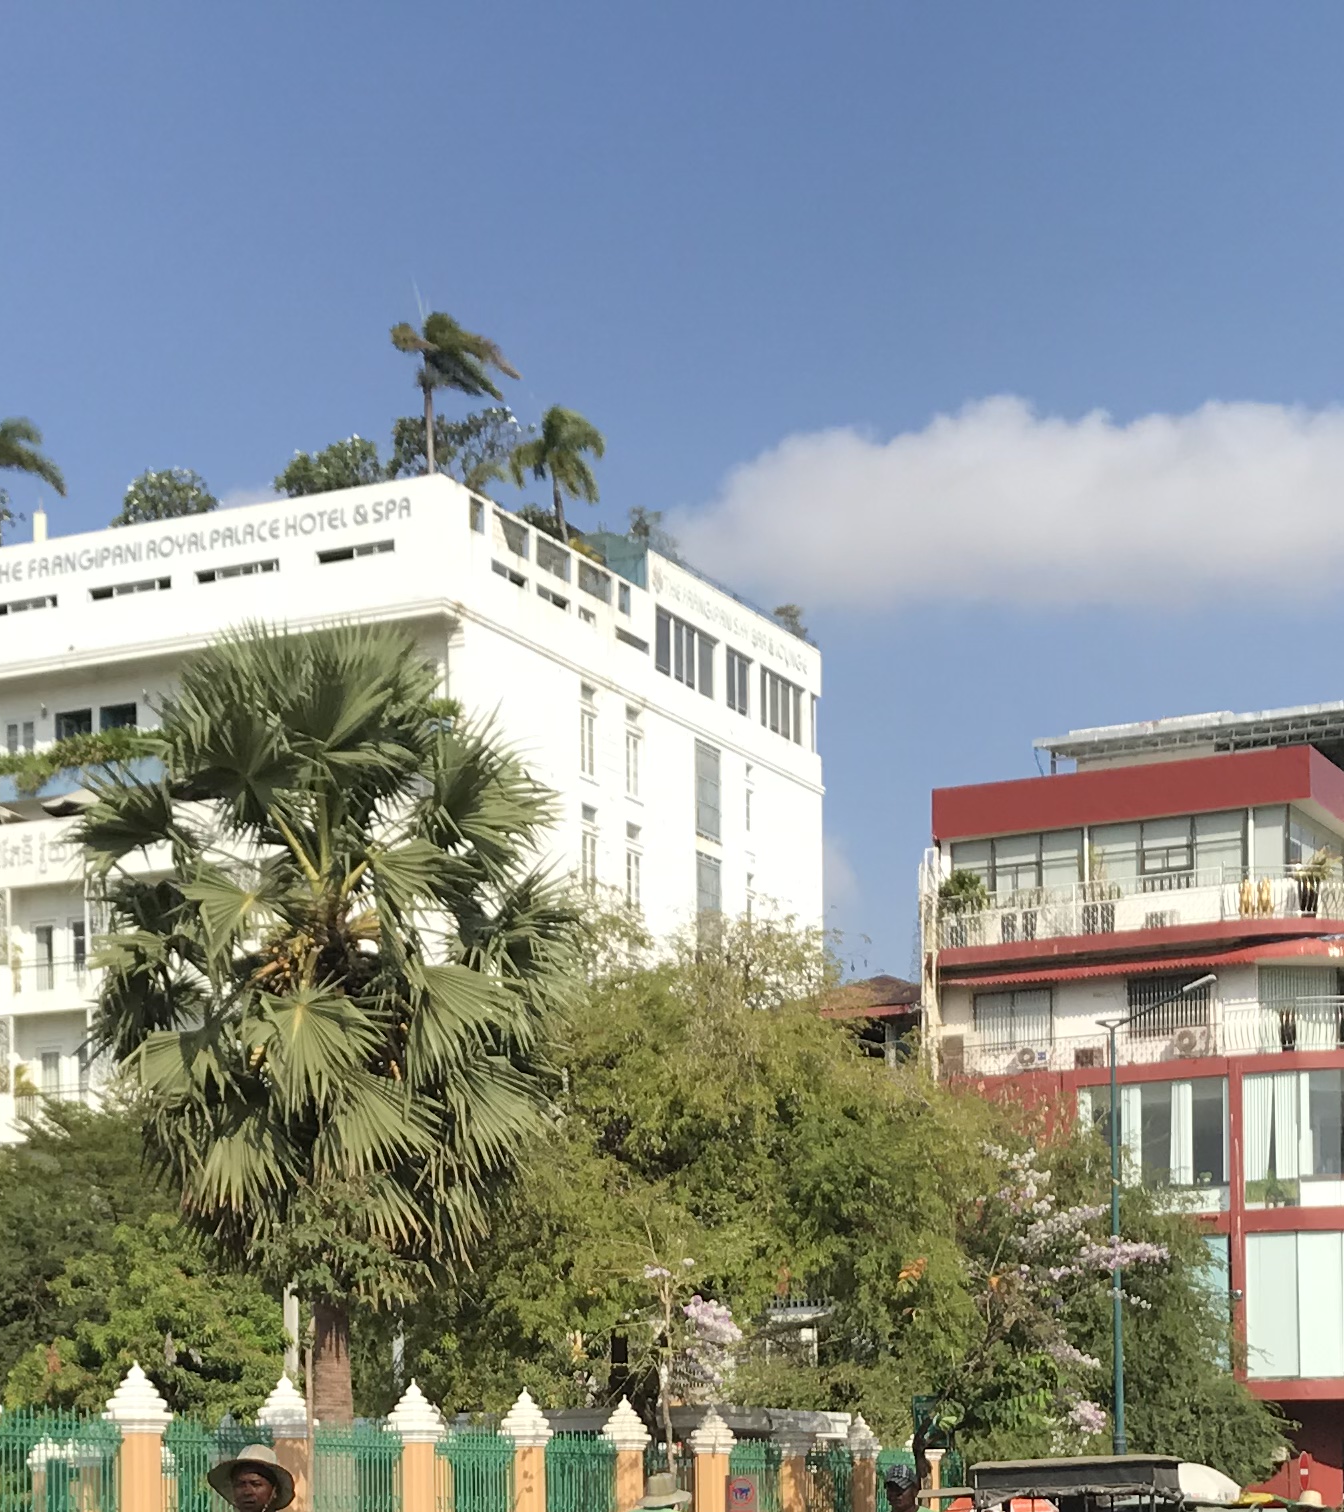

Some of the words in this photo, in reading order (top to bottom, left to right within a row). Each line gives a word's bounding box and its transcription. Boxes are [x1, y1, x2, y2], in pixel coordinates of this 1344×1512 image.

[28, 541, 142, 579] FRANGIPANI
[146, 531, 206, 561] ROYAL
[209, 518, 280, 550] PALACE
[284, 507, 348, 537] HOTEL
[352, 504, 368, 526] &
[372, 497, 412, 524] SPA
